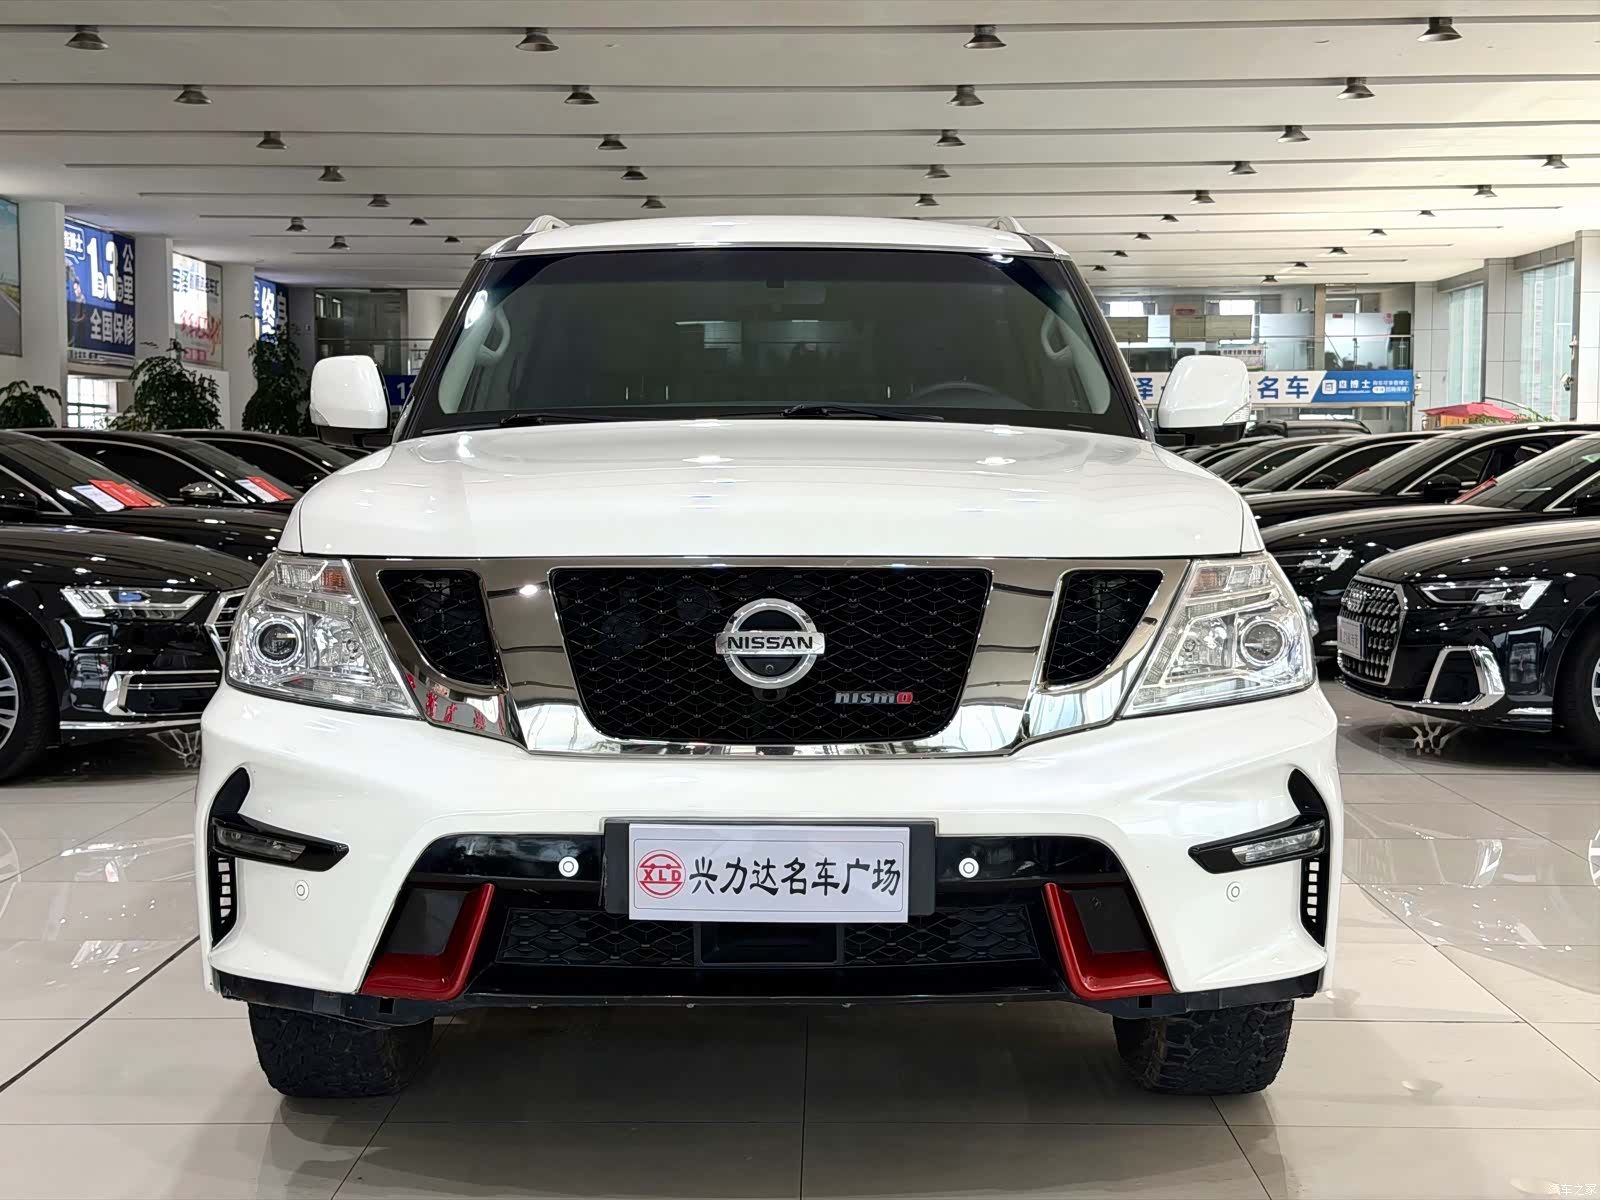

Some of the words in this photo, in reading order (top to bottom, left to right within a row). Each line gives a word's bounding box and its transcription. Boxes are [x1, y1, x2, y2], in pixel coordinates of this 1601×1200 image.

[89, 307, 134, 346] 全国保修
[1249, 375, 1309, 399] 名车
[727, 636, 813, 650] NISSAN
[643, 868, 682, 882] XLD
[689, 856, 901, 896] 兴力达名车广场
